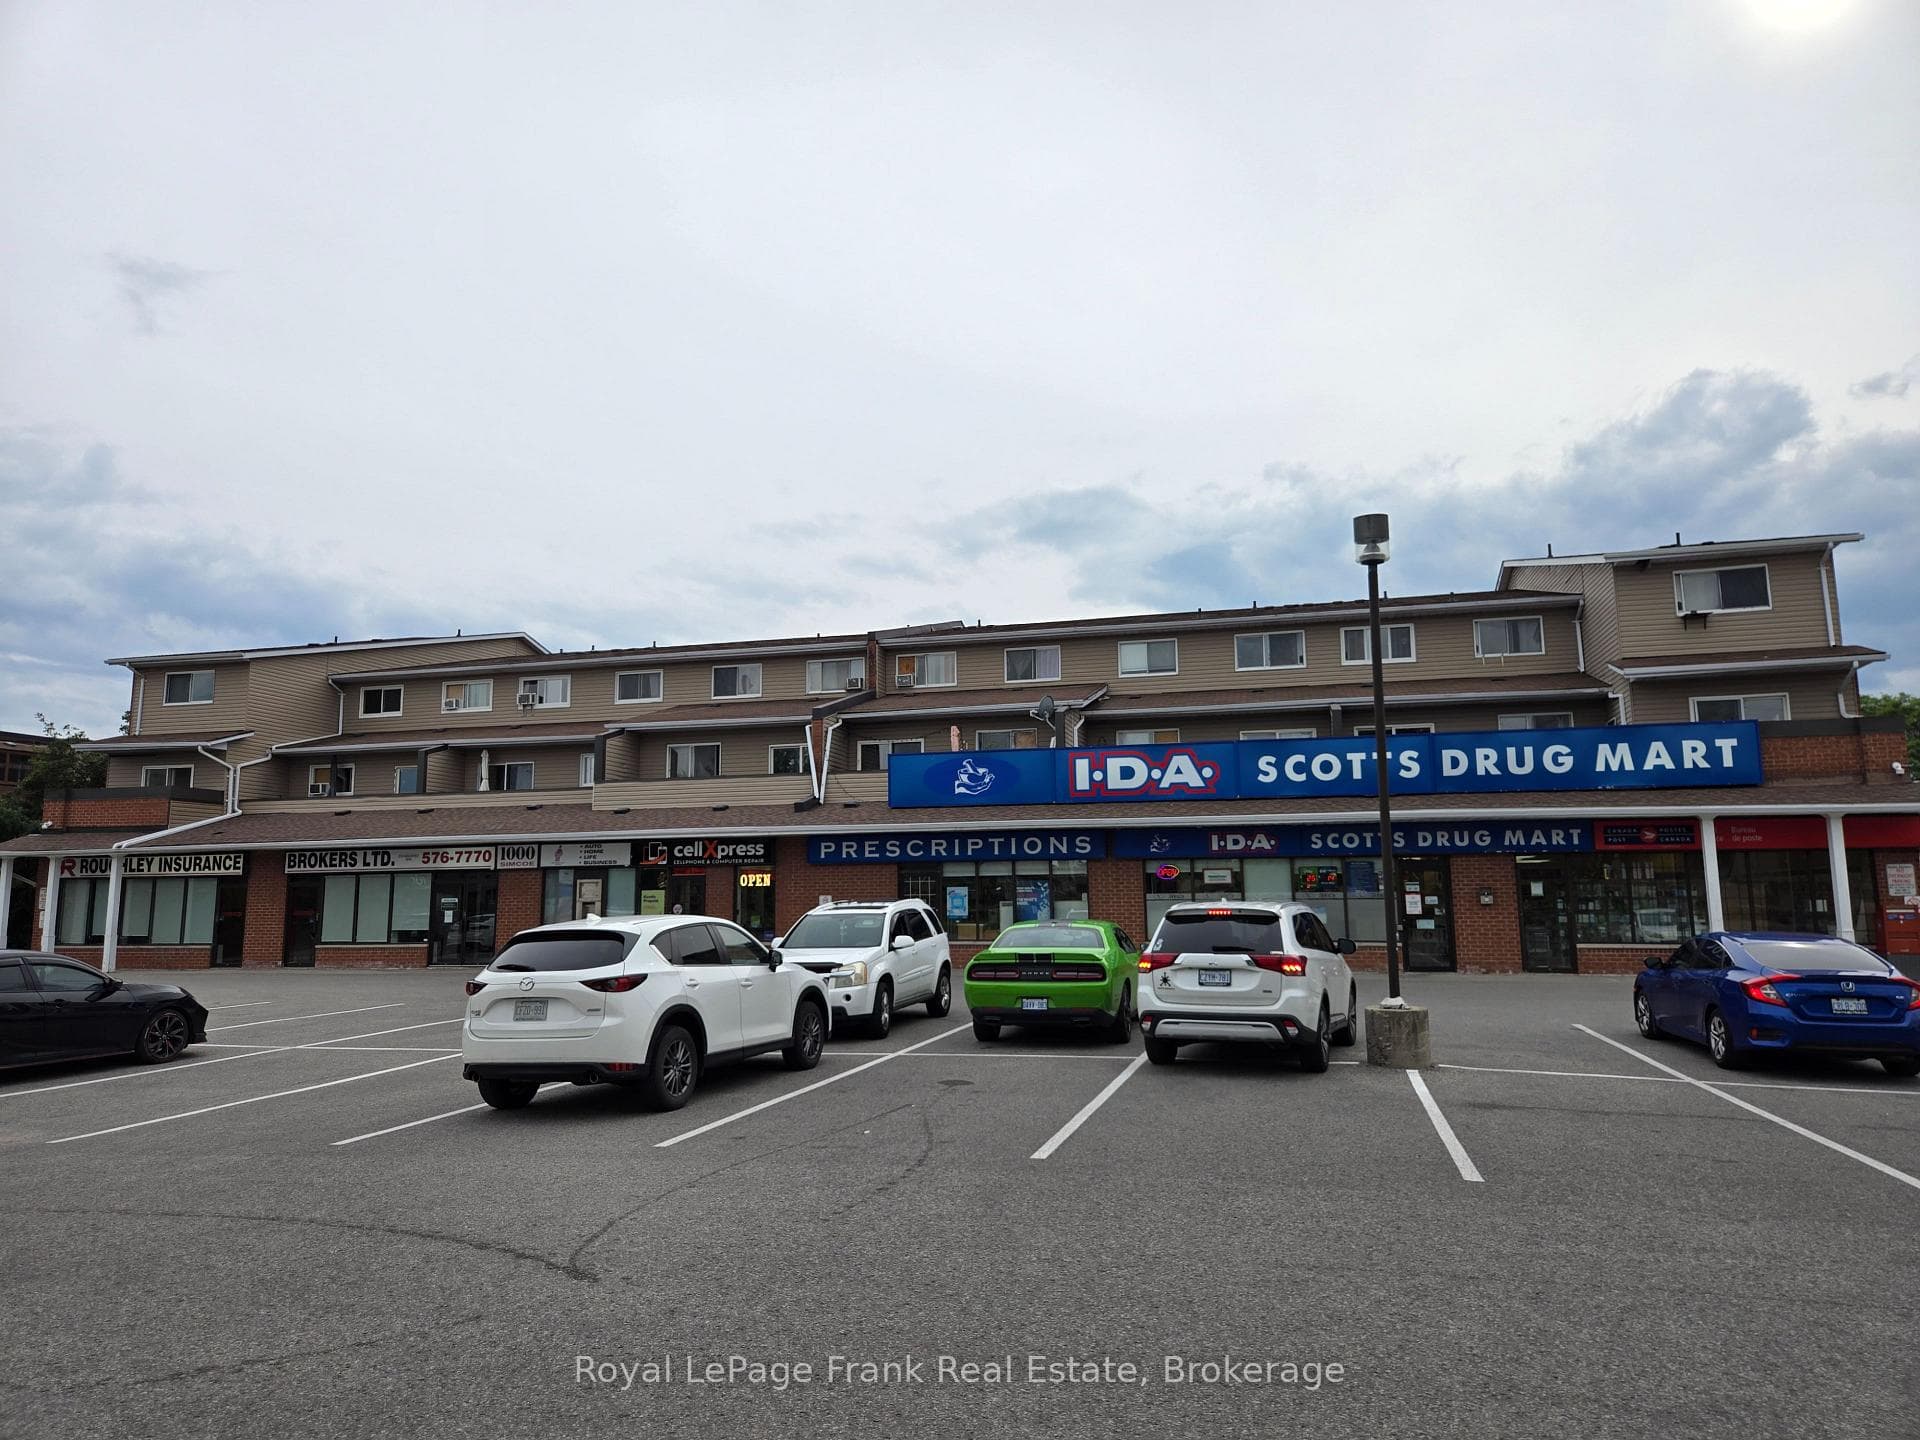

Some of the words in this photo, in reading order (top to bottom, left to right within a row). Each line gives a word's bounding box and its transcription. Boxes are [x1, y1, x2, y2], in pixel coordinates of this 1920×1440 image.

[1442, 744, 1574, 776] DRUG
[1595, 738, 1739, 772] MART
[1418, 829, 1491, 847] DRUG
[1503, 827, 1582, 846] MART
[421, 849, 493, 864] 576-7770
[500, 846, 535, 861] 1000
[673, 840, 765, 860] cellXpress
[819, 836, 1092, 859] PRESCRIPTIONS
[79, 856, 154, 874] ROUHLEY
[158, 854, 242, 873] INSURANCE
[287, 851, 358, 869] BROKERS
[362, 850, 395, 868] LTD.
[739, 873, 771, 887] OPEN
